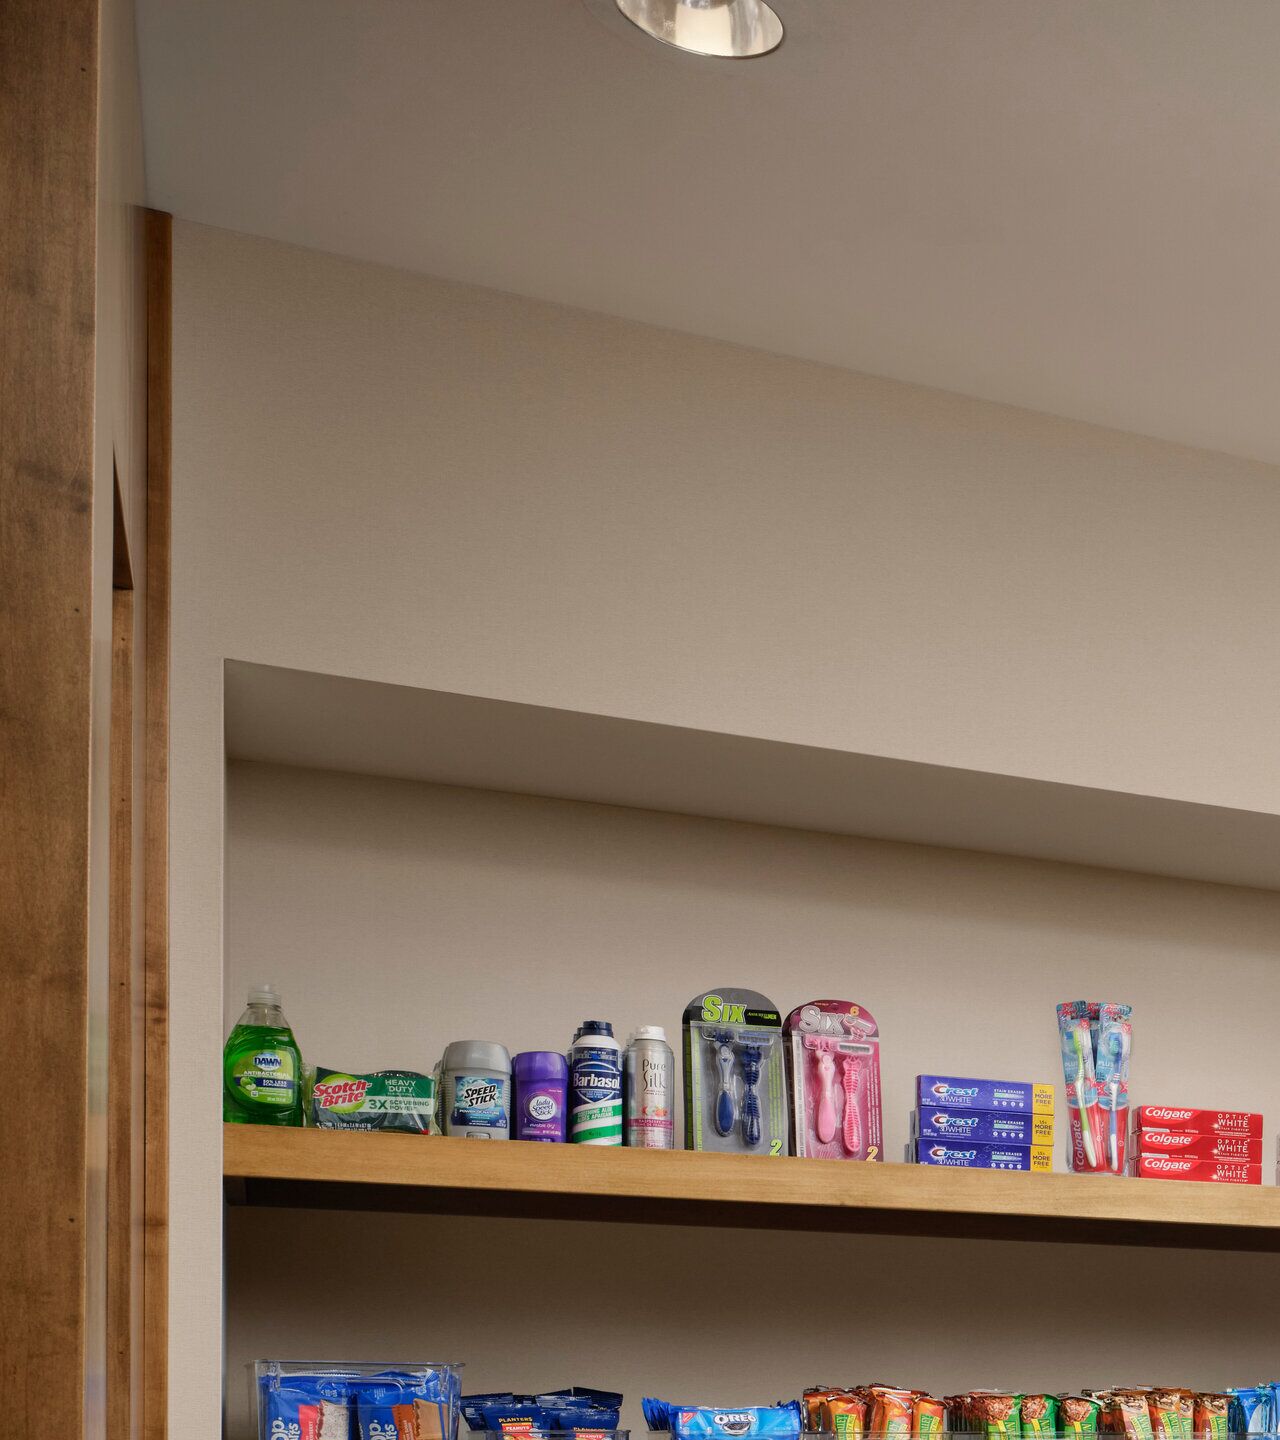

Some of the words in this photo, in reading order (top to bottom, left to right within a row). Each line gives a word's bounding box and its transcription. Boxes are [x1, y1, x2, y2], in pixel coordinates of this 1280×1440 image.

[254, 1056, 282, 1067] DAWN
[573, 1073, 621, 1090] Barbasol
[464, 1085, 497, 1099] SPEED
[933, 1084, 979, 1097] Crest
[321, 1091, 365, 1108] Brite
[368, 1099, 389, 1110] 3X
[468, 1095, 497, 1108] STICK
[933, 1114, 979, 1127] Crest
[1145, 1107, 1192, 1121] Colgate
[1217, 1113, 1250, 1121] OPTIC
[1218, 1119, 1248, 1128] WHITE
[1145, 1132, 1191, 1145] Colgate
[1217, 1138, 1250, 1146] OPTIC
[931, 1146, 977, 1159] Crest
[1217, 1144, 1248, 1153] WHITE
[1144, 1158, 1191, 1171] Colgate
[1216, 1170, 1248, 1178] WHITE
